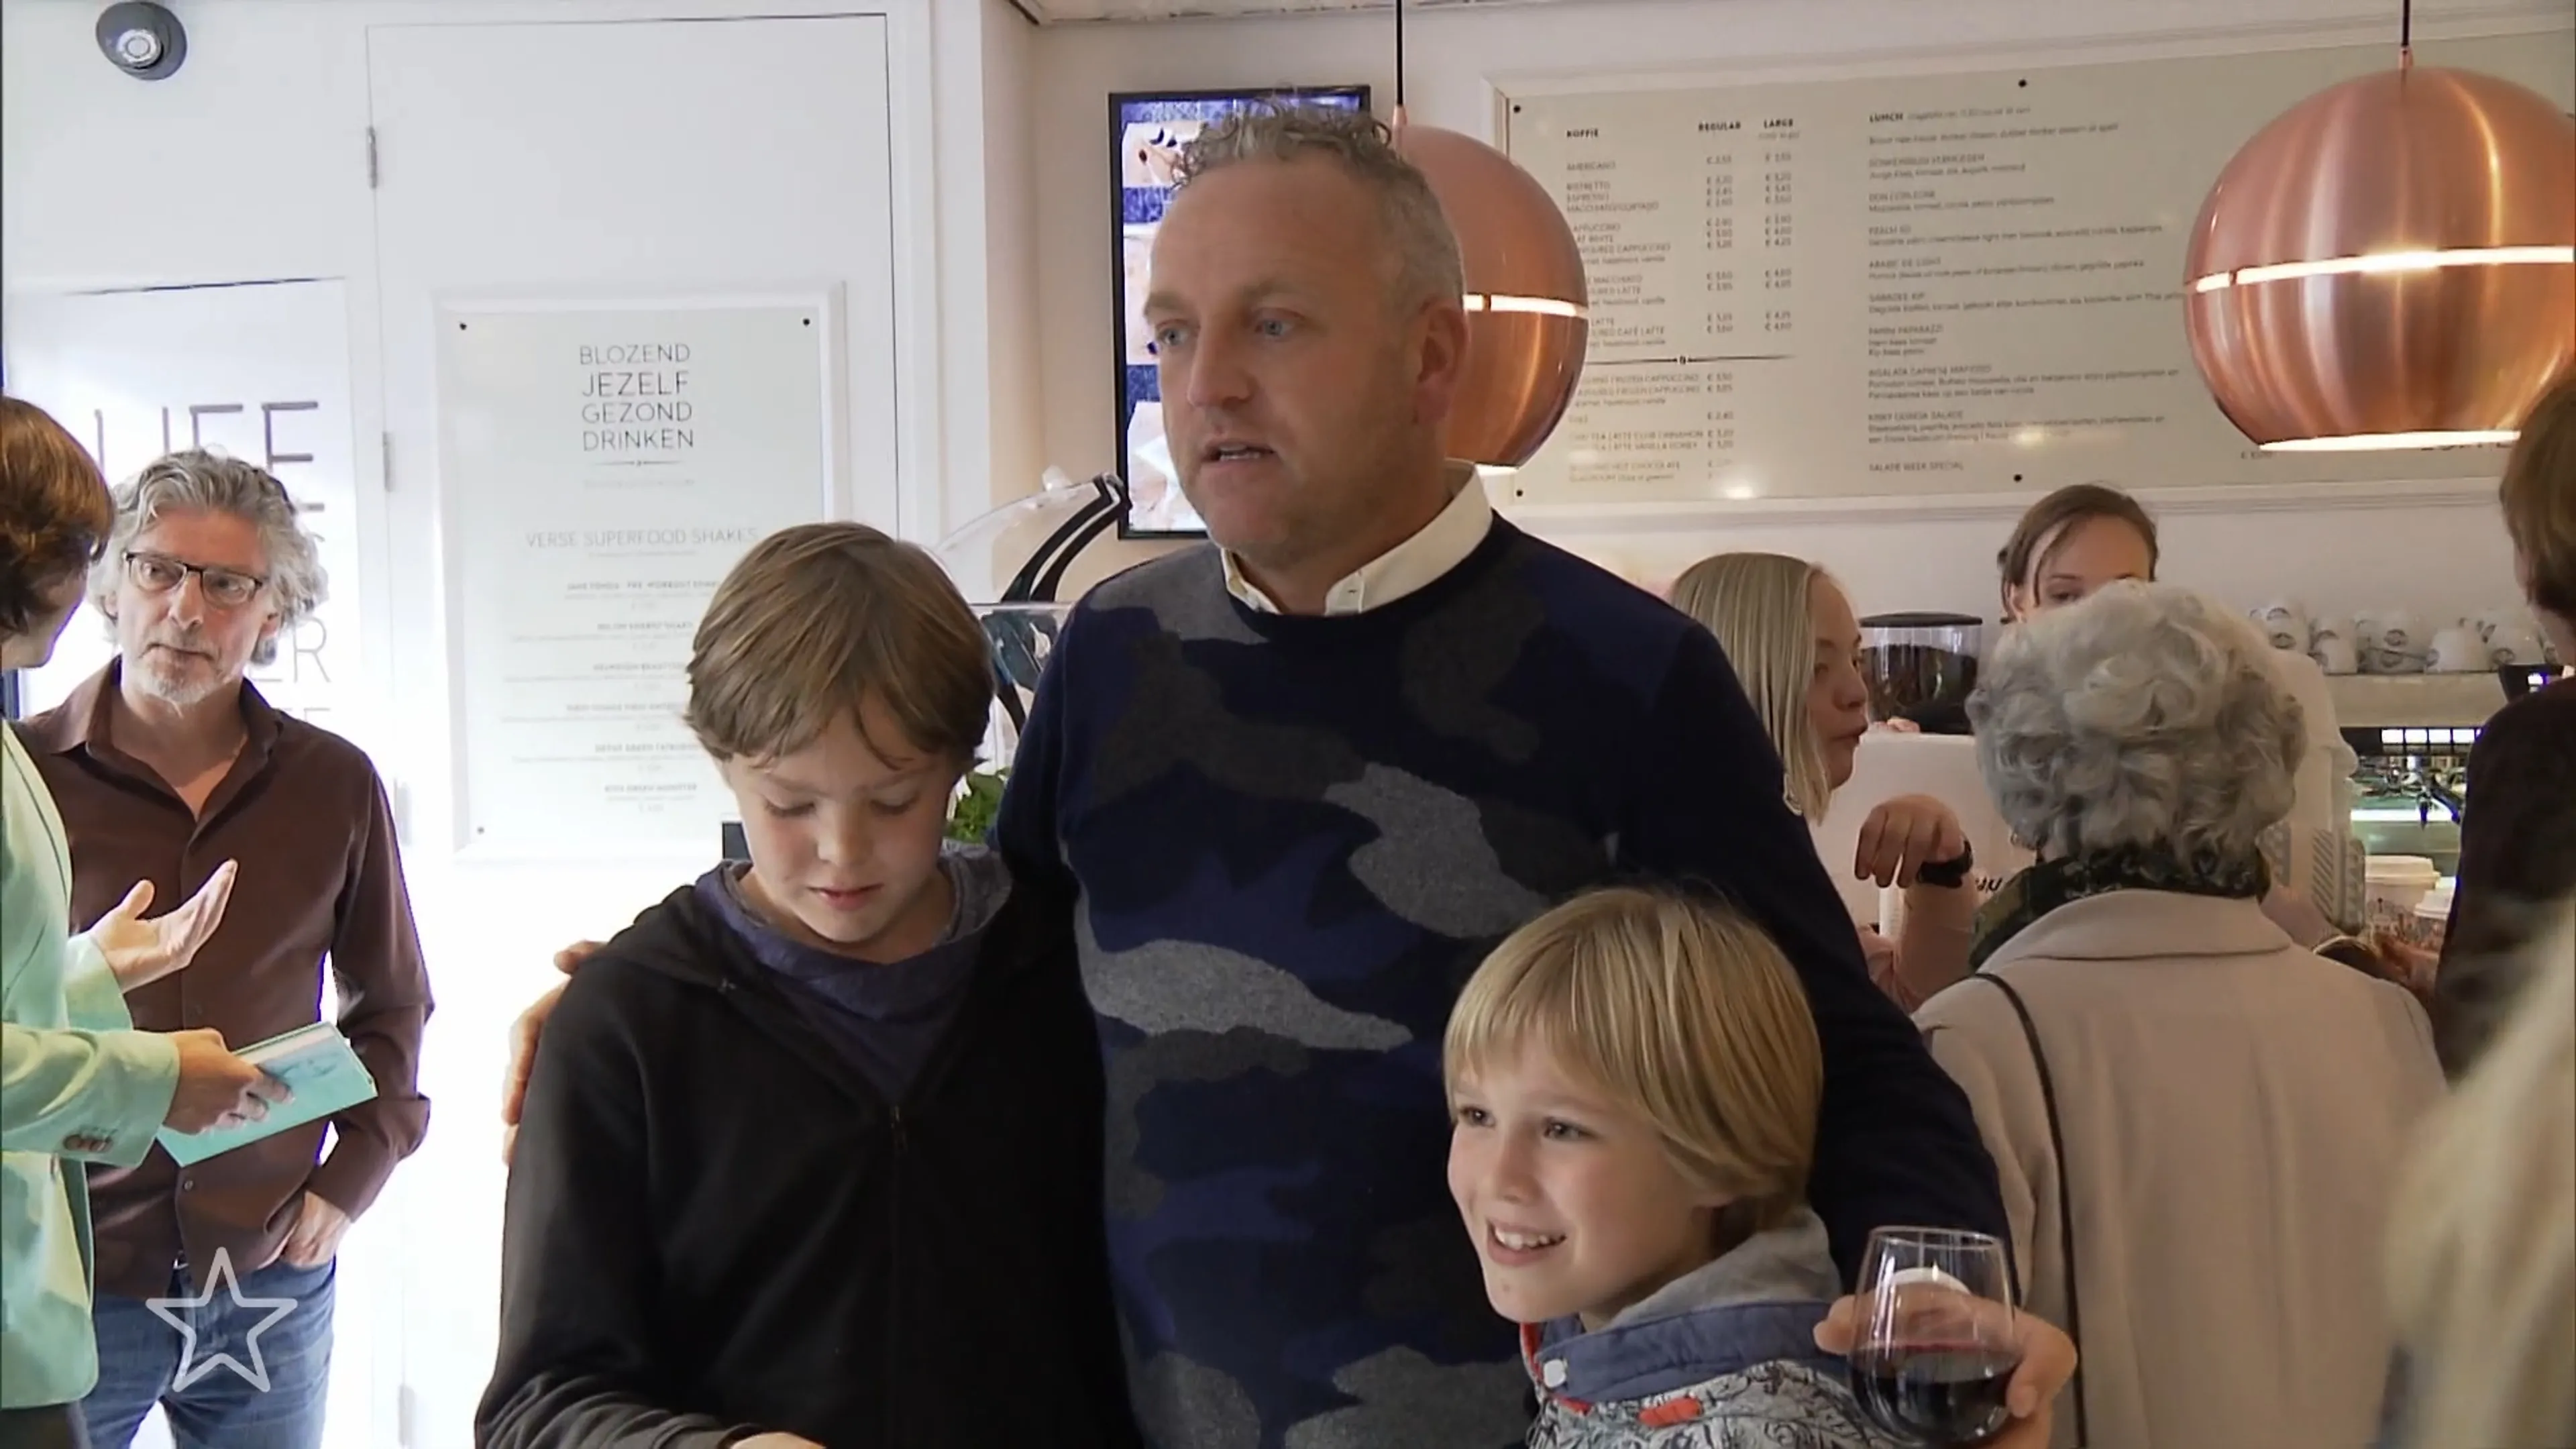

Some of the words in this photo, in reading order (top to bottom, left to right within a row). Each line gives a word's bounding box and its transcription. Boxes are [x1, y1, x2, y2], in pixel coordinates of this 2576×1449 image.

[1566, 127, 1599, 138] KOFFIE
[1699, 121, 1741, 132] REGULAR
[1764, 118, 1793, 129] LARGE
[1573, 222, 1620, 233] APPUCCINO
[579, 343, 691, 366] BLOZEND
[582, 371, 689, 398] JEZELF
[582, 401, 692, 424] GEZOND
[583, 429, 694, 451] DRINKEN
[525, 531, 577, 549] VERSE
[584, 529, 687, 547] SUPERFOOD
[692, 527, 758, 545] SHAKES
